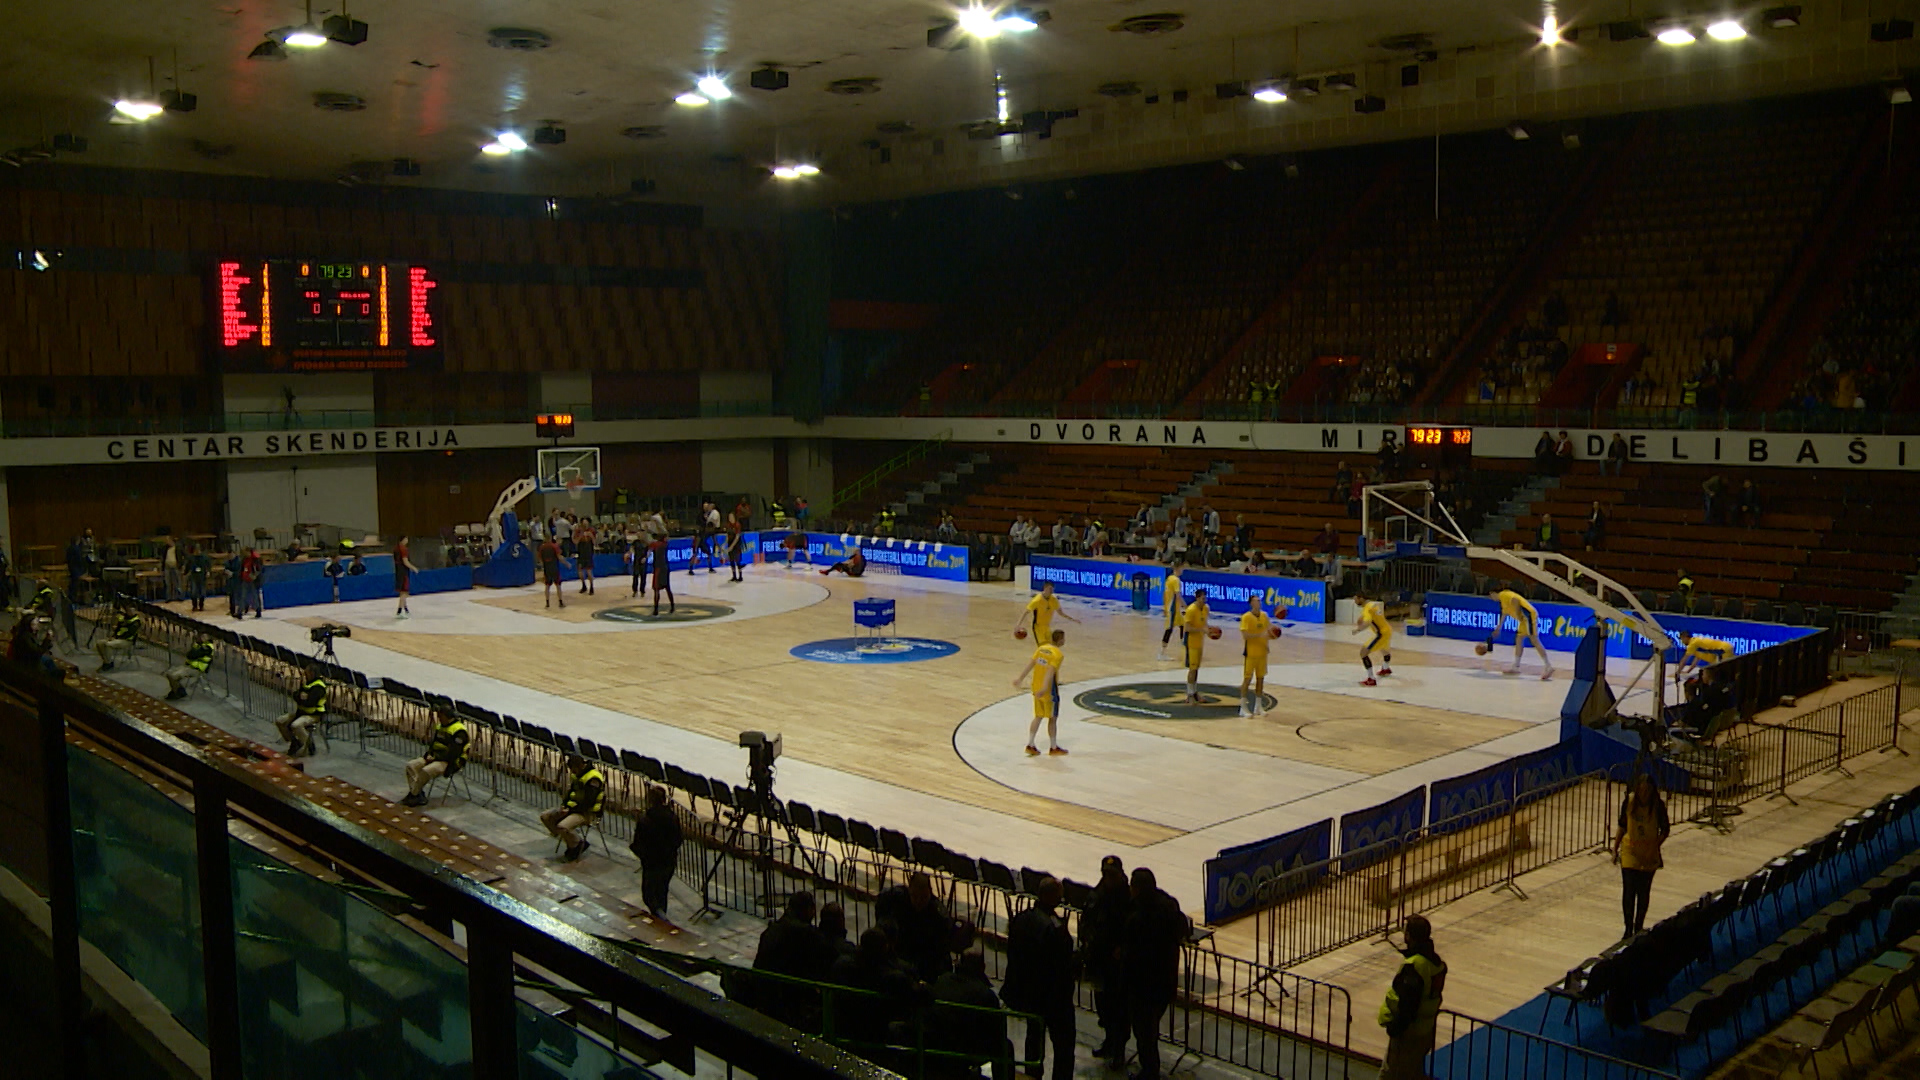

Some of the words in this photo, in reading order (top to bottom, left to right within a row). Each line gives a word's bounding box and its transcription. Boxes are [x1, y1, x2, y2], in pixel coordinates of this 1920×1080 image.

[107, 437, 244, 459] CENTAR
[266, 430, 458, 453] SKENDERIJA
[1030, 423, 1206, 443] DVORANA
[1033, 566, 1046, 581] FIBA
[1046, 567, 1080, 584] BASKETBALL
[1080, 570, 1101, 587] WORLD
[1101, 573, 1113, 588] CUP
[1225, 586, 1249, 602] WORLD
[1298, 589, 1321, 610] 2019
[1431, 606, 1449, 624] FIBA
[1450, 609, 1500, 630] BASKETBALL
[1553, 615, 1586, 638] Chin
[1439, 779, 1506, 828] JOOLA
[1215, 853, 1308, 912] JOOLA
